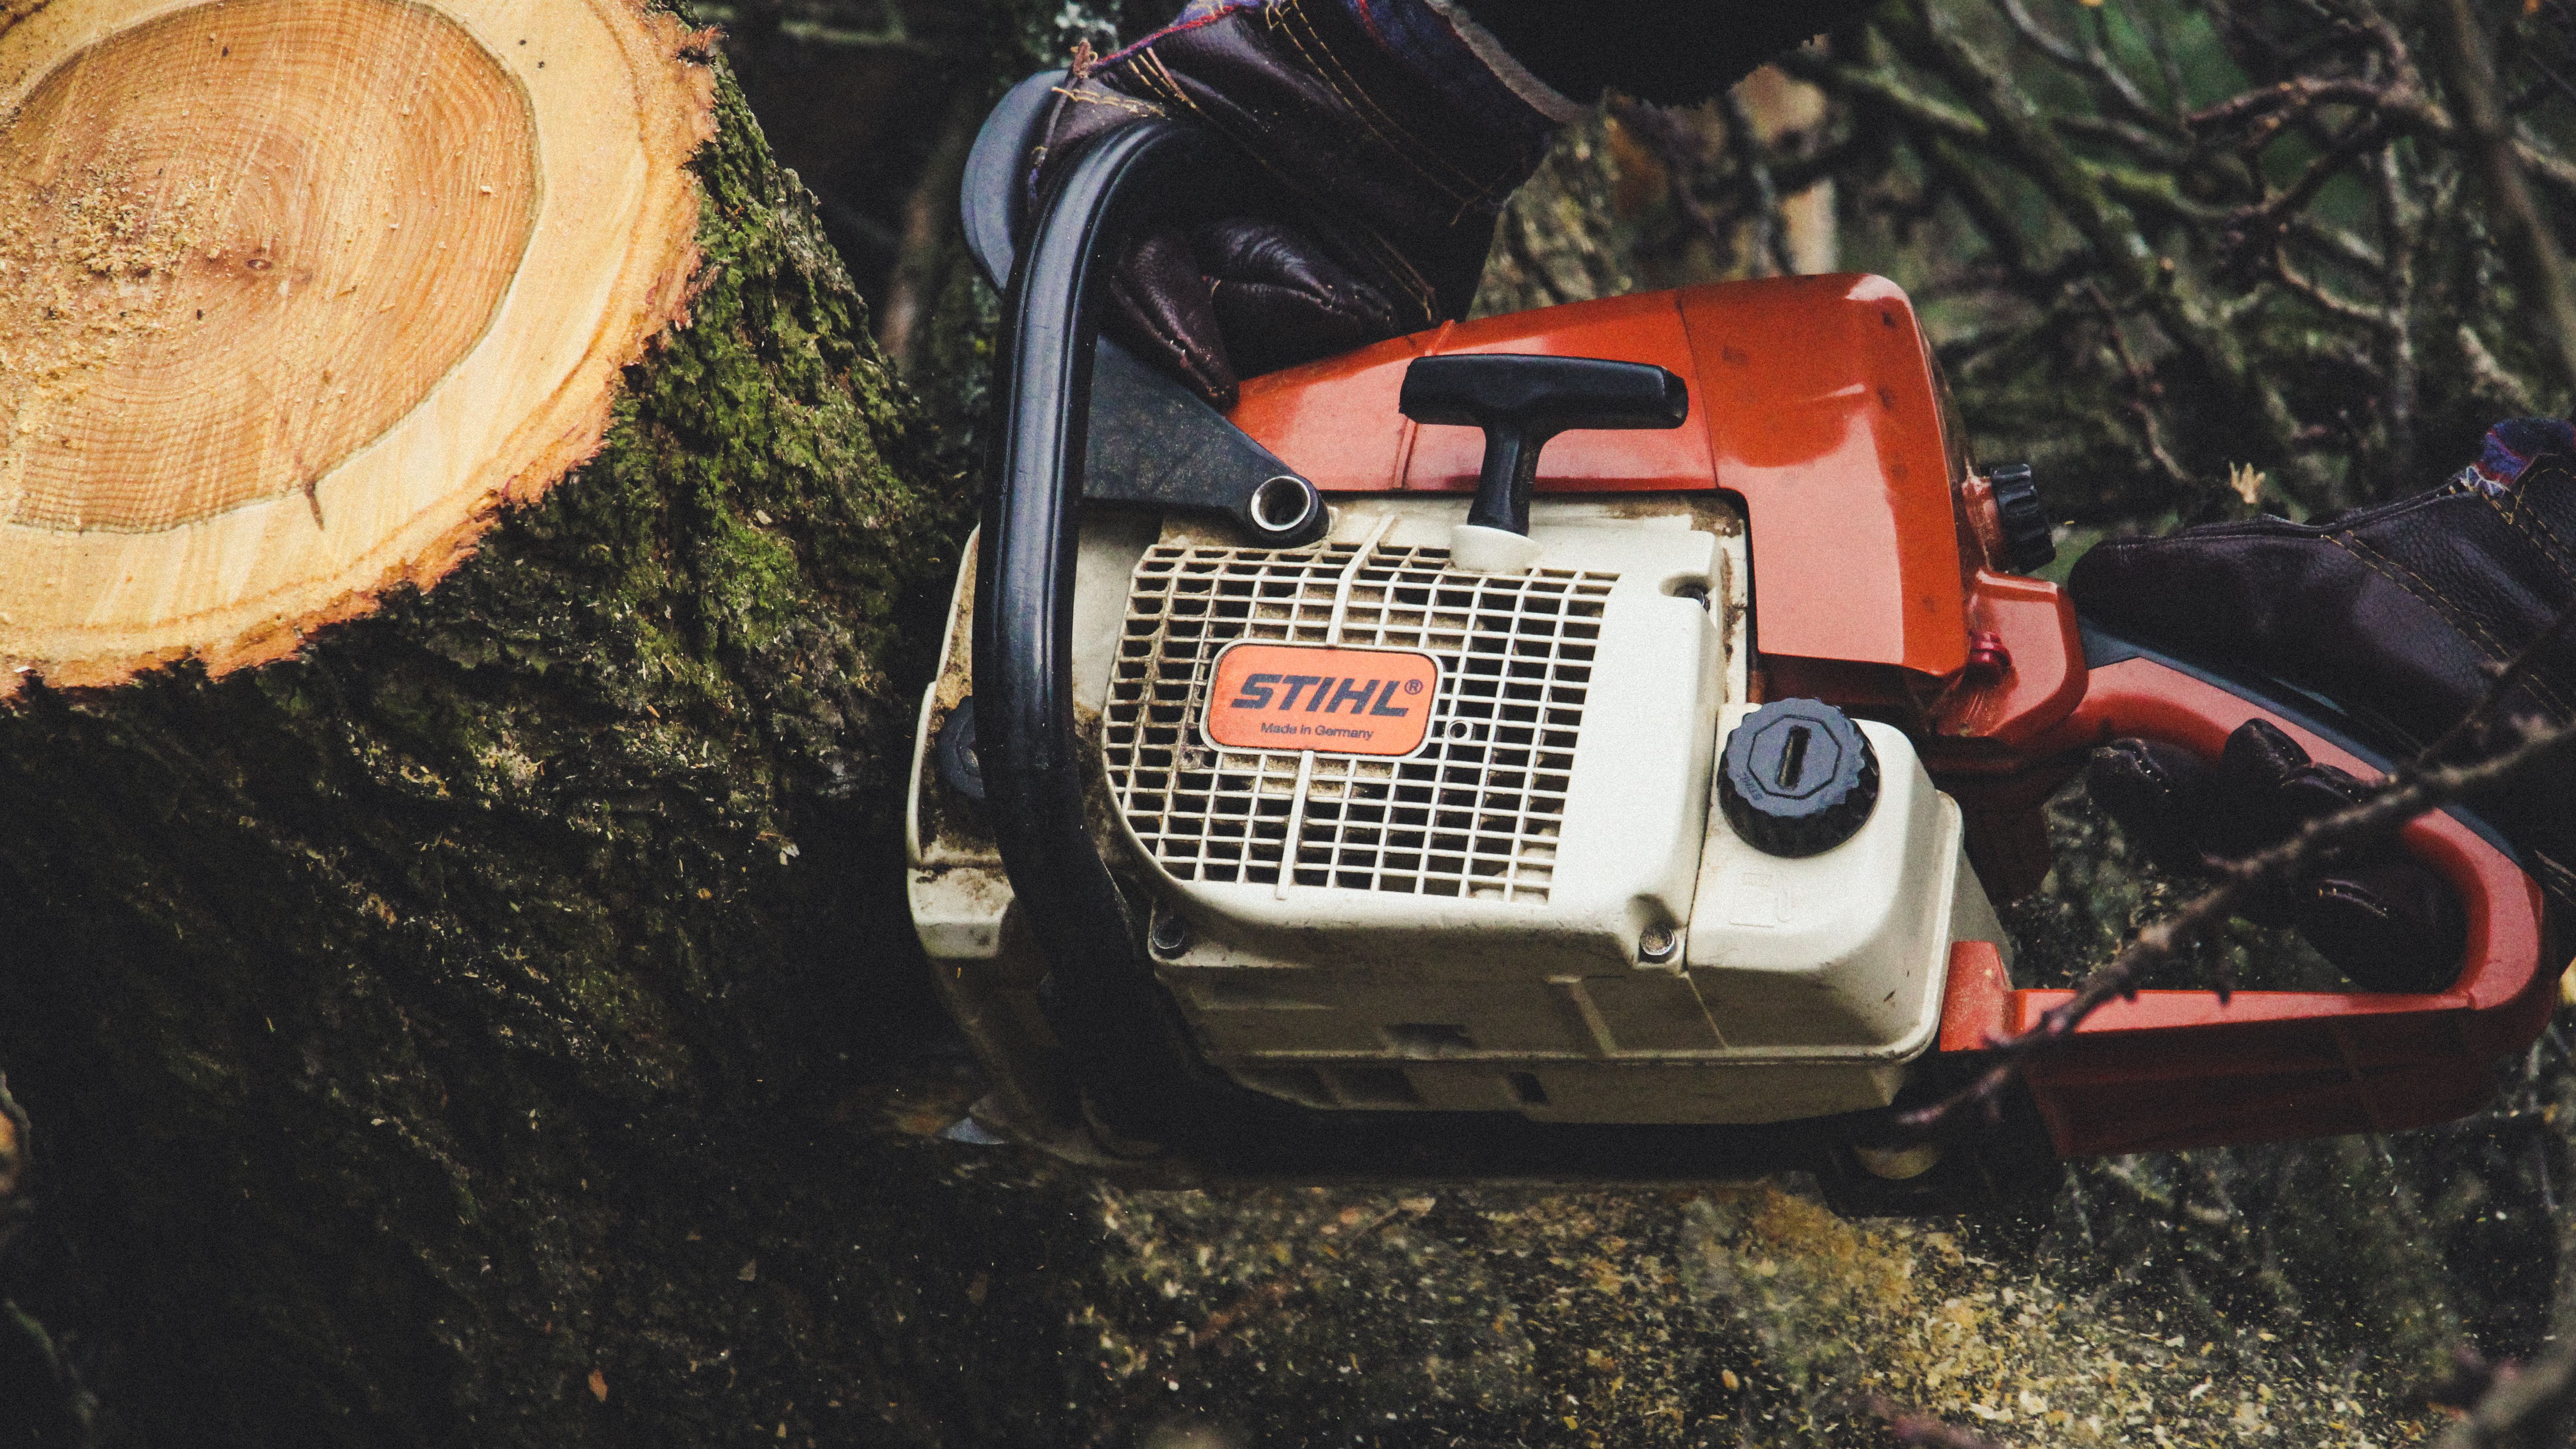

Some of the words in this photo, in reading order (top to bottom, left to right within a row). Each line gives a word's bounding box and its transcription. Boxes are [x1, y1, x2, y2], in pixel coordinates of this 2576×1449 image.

[1261, 723, 1297, 734] Made
[1300, 724, 1312, 735] in
[1315, 725, 1374, 740] Germany
